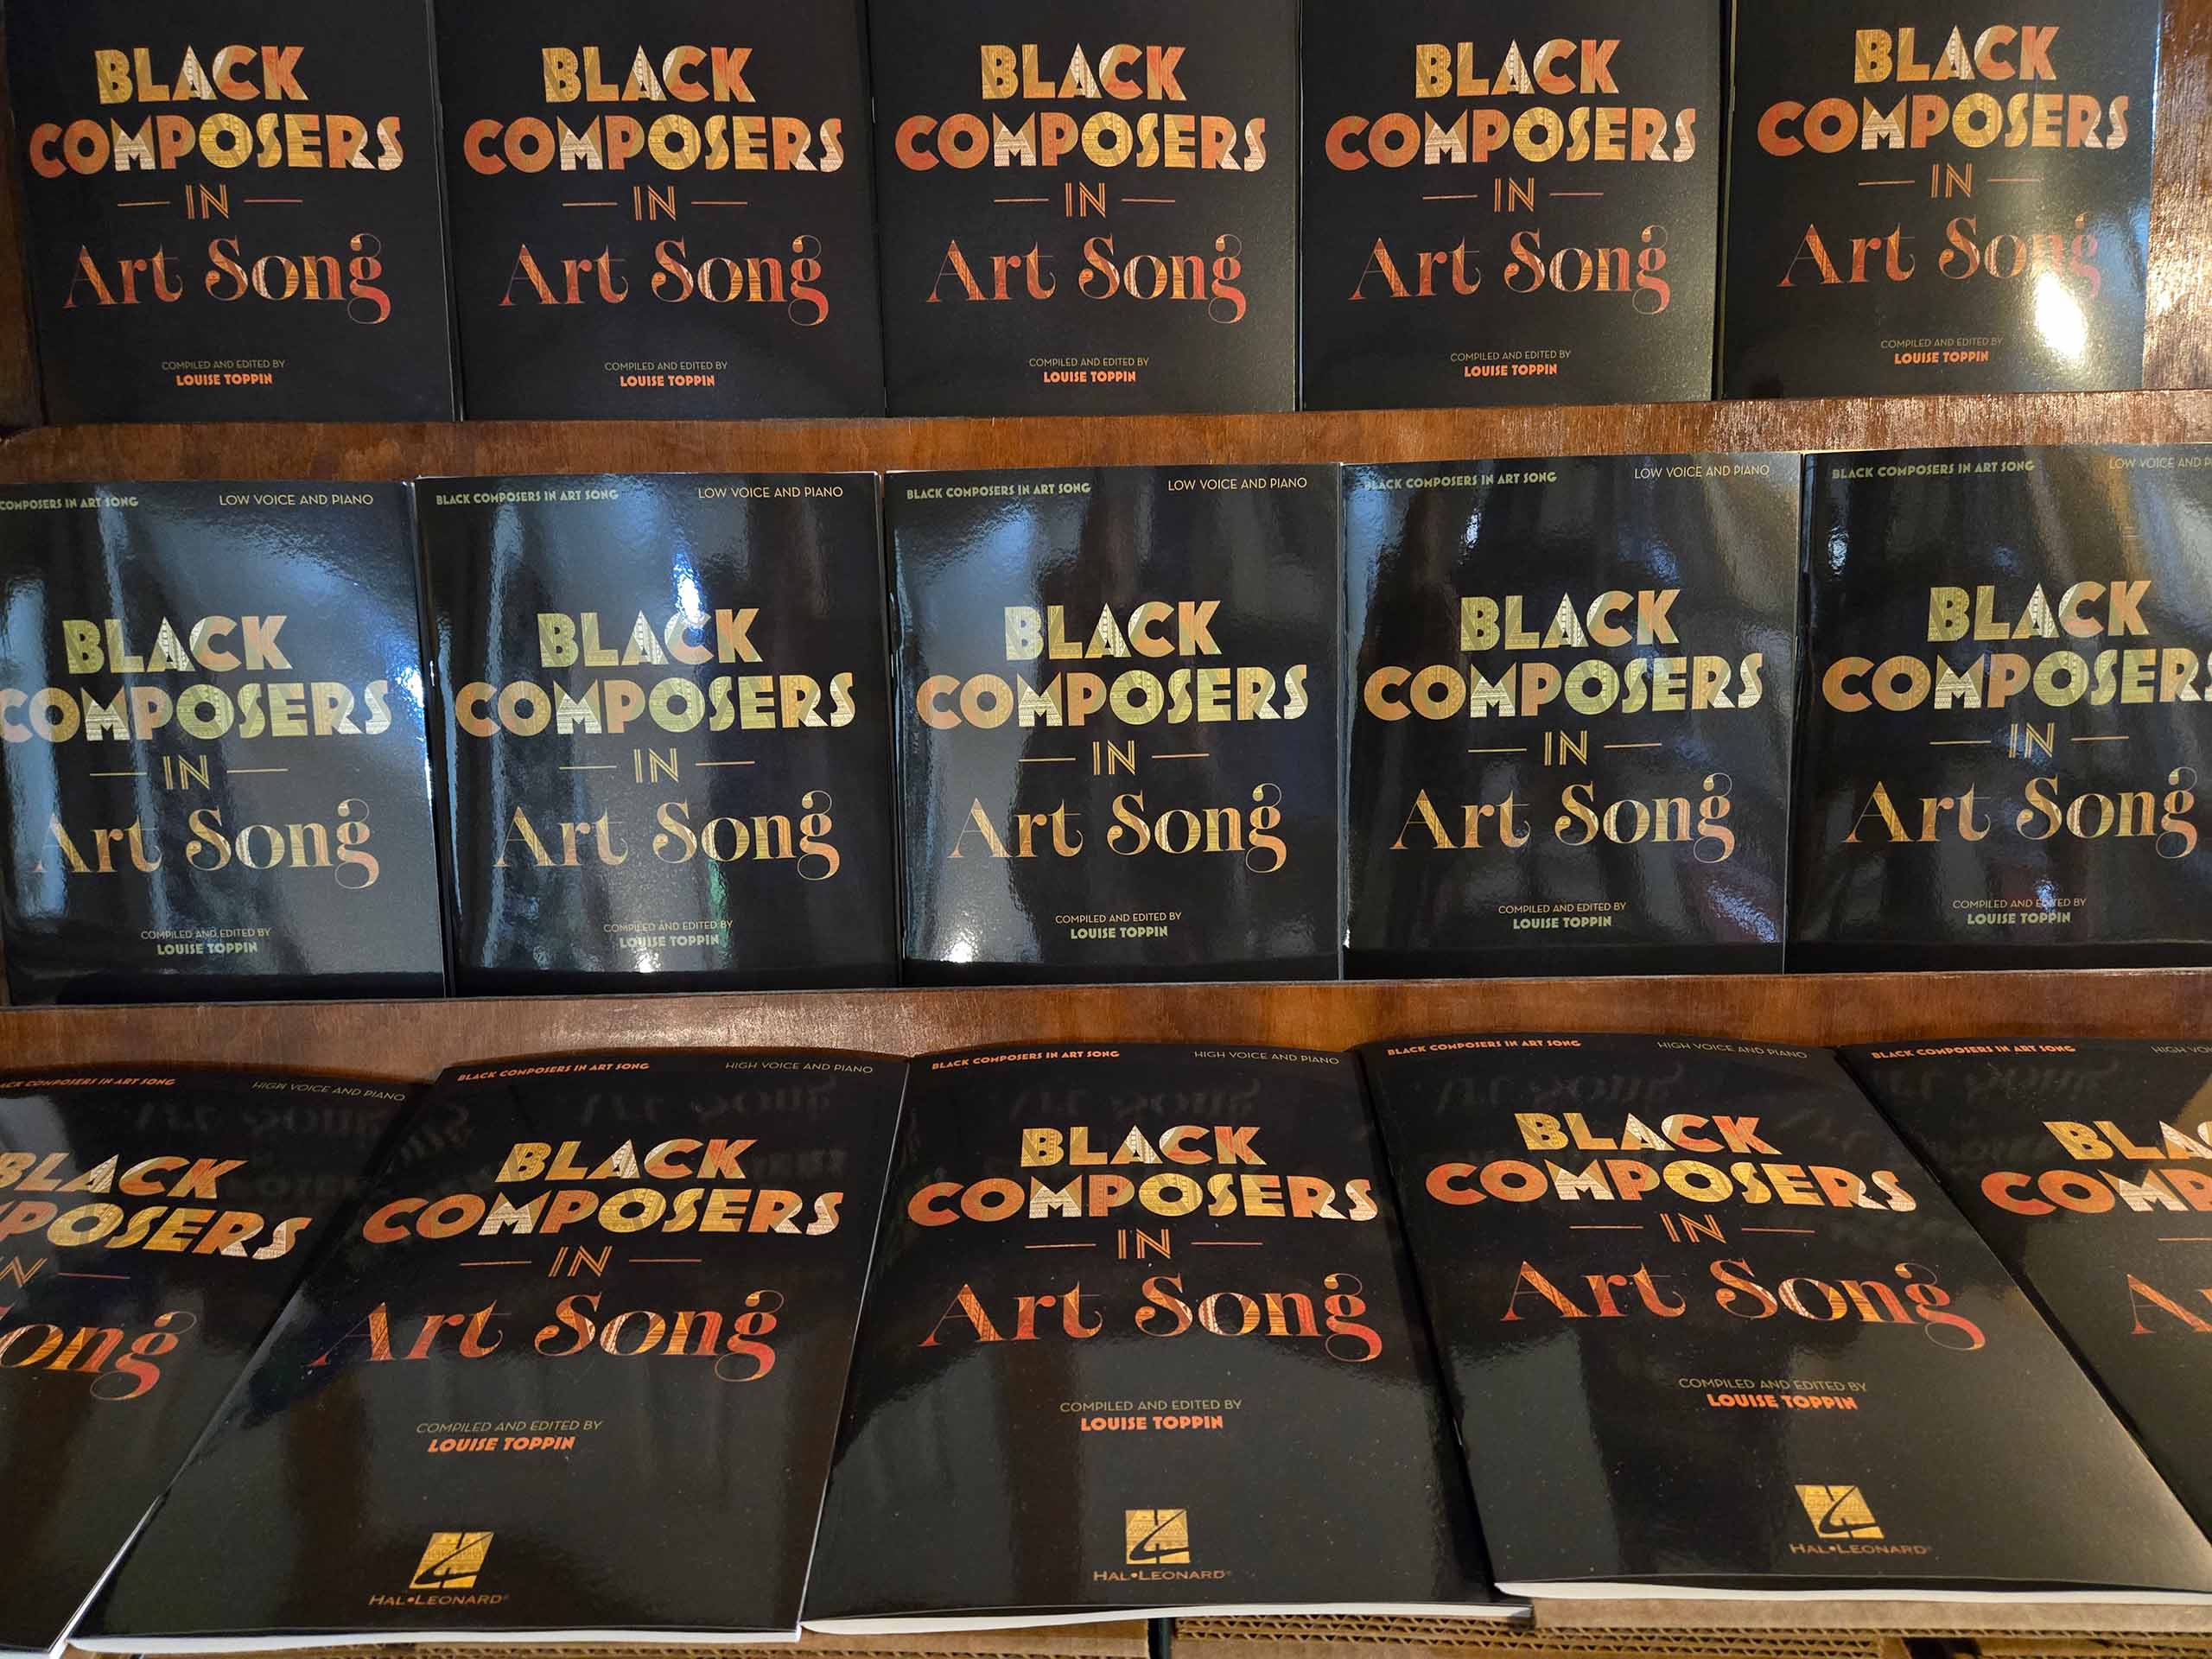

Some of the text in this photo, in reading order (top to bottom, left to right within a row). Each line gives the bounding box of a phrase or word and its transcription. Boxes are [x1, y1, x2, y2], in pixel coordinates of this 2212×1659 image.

[981, 42, 1187, 101] BLACK
[1415, 39, 1620, 99] BLACK
[1854, 25, 2060, 83] BLACK
[94, 45, 309, 104] BLACK
[543, 46, 755, 104] BLACK
[463, 113, 844, 175] COMPOSERS
[895, 111, 1267, 173] COMPOSERS
[1325, 107, 1695, 172] COMPOSERS
[1758, 93, 2129, 156] COMPOSERS
[29, 112, 403, 178] COMPOSERS
[1065, 181, 1106, 218] IN
[1494, 177, 1534, 213] IN
[1930, 163, 1973, 199] IN
[185, 185, 229, 220] IN
[633, 185, 677, 221] IN
[1348, 225, 1672, 315] Art Song
[1777, 223, 1915, 288] Art
[63, 232, 391, 324] Art Song
[500, 234, 830, 327] Art Song
[926, 232, 1247, 324] Art Song
[1029, 357, 1149, 366] COMPILED AND EDITED BY
[1465, 364, 1557, 377] LOUISE TOPPIN
[1894, 351, 1989, 364] LOUISE TOPPIN
[176, 373, 272, 386] LOUISE TOPPIN
[620, 375, 715, 386] LOUISE TOPPIN
[1044, 372, 1135, 383] LOUISE TOPPIN
[1169, 478, 1306, 491] LOW VOICE AND PIANO
[1635, 465, 1770, 479] LOW VOICE AND PIANO
[1832, 461, 2036, 479] BLACK COMPOSERS IN ART SONG
[219, 494, 373, 505] LOW VOICE AND PIANO
[436, 489, 619, 505] BLACK COMPOSERS IN ART SONG
[699, 486, 842, 498] LOW VOICE AND PIANO
[907, 483, 1091, 499] BLACK COMPOSERS IN ART SONG
[1005, 601, 1221, 661] BLACK
[1461, 588, 1681, 652] BLACK
[1928, 581, 2152, 643] BLACK
[62, 614, 292, 675] BLACK
[537, 607, 763, 668] BLACK
[456, 672, 855, 738] COMPOSERS
[917, 664, 1308, 730] COMPOSERS
[1364, 652, 1763, 720] COMPOSERS
[0, 679, 391, 743] COMPOSERS
[1093, 741, 1135, 776] IN
[1544, 730, 1587, 766] IN
[2009, 721, 2054, 759] IN
[164, 754, 208, 791] IN
[634, 747, 678, 784] IN
[948, 783, 1287, 874] Art Song
[1390, 772, 1734, 863] Art Song
[1843, 766, 2197, 859] Art Song
[33, 798, 380, 889] Art Song
[493, 790, 841, 881] Art Song
[1056, 912, 1181, 924] COMPILED AND EDITED BY
[1071, 926, 1168, 939] LOUISE TOPPIN
[1513, 916, 1611, 929] LOUISE TOPPIN
[1967, 912, 2070, 925] LOUISE TOPPIN
[157, 942, 257, 955] LOUISE TOPPIN
[834, 1065, 874, 1073] PIANO
[931, 1058, 969, 1070] BLACK
[973, 1052, 1043, 1065] COMPOSERS
[1300, 1055, 1339, 1064] PIANO
[1020, 1125, 1267, 1167] BLACK
[1514, 1113, 1783, 1154] BLACK
[495, 1139, 757, 1183] BLACK
[907, 1173, 1379, 1227] COMPOSERS
[1426, 1160, 1916, 1212] COMPOSERS
[362, 1188, 843, 1244] COMPOSERS
[1661, 1214, 1728, 1244] IN
[548, 1246, 613, 1277] IN
[1118, 1229, 1171, 1259] IN
[918, 1272, 1383, 1362] Art Song
[1500, 1259, 1986, 1351] Art Song
[305, 1289, 785, 1382] Art Song
[1060, 1400, 1243, 1413] COMPILED AND EDITED BY
[1707, 1394, 1857, 1409] LOUISE TOPPIN
[1081, 1415, 1223, 1431] LOUISE TOPPIN
[428, 1437, 575, 1452] LOUISE TOPPIN
